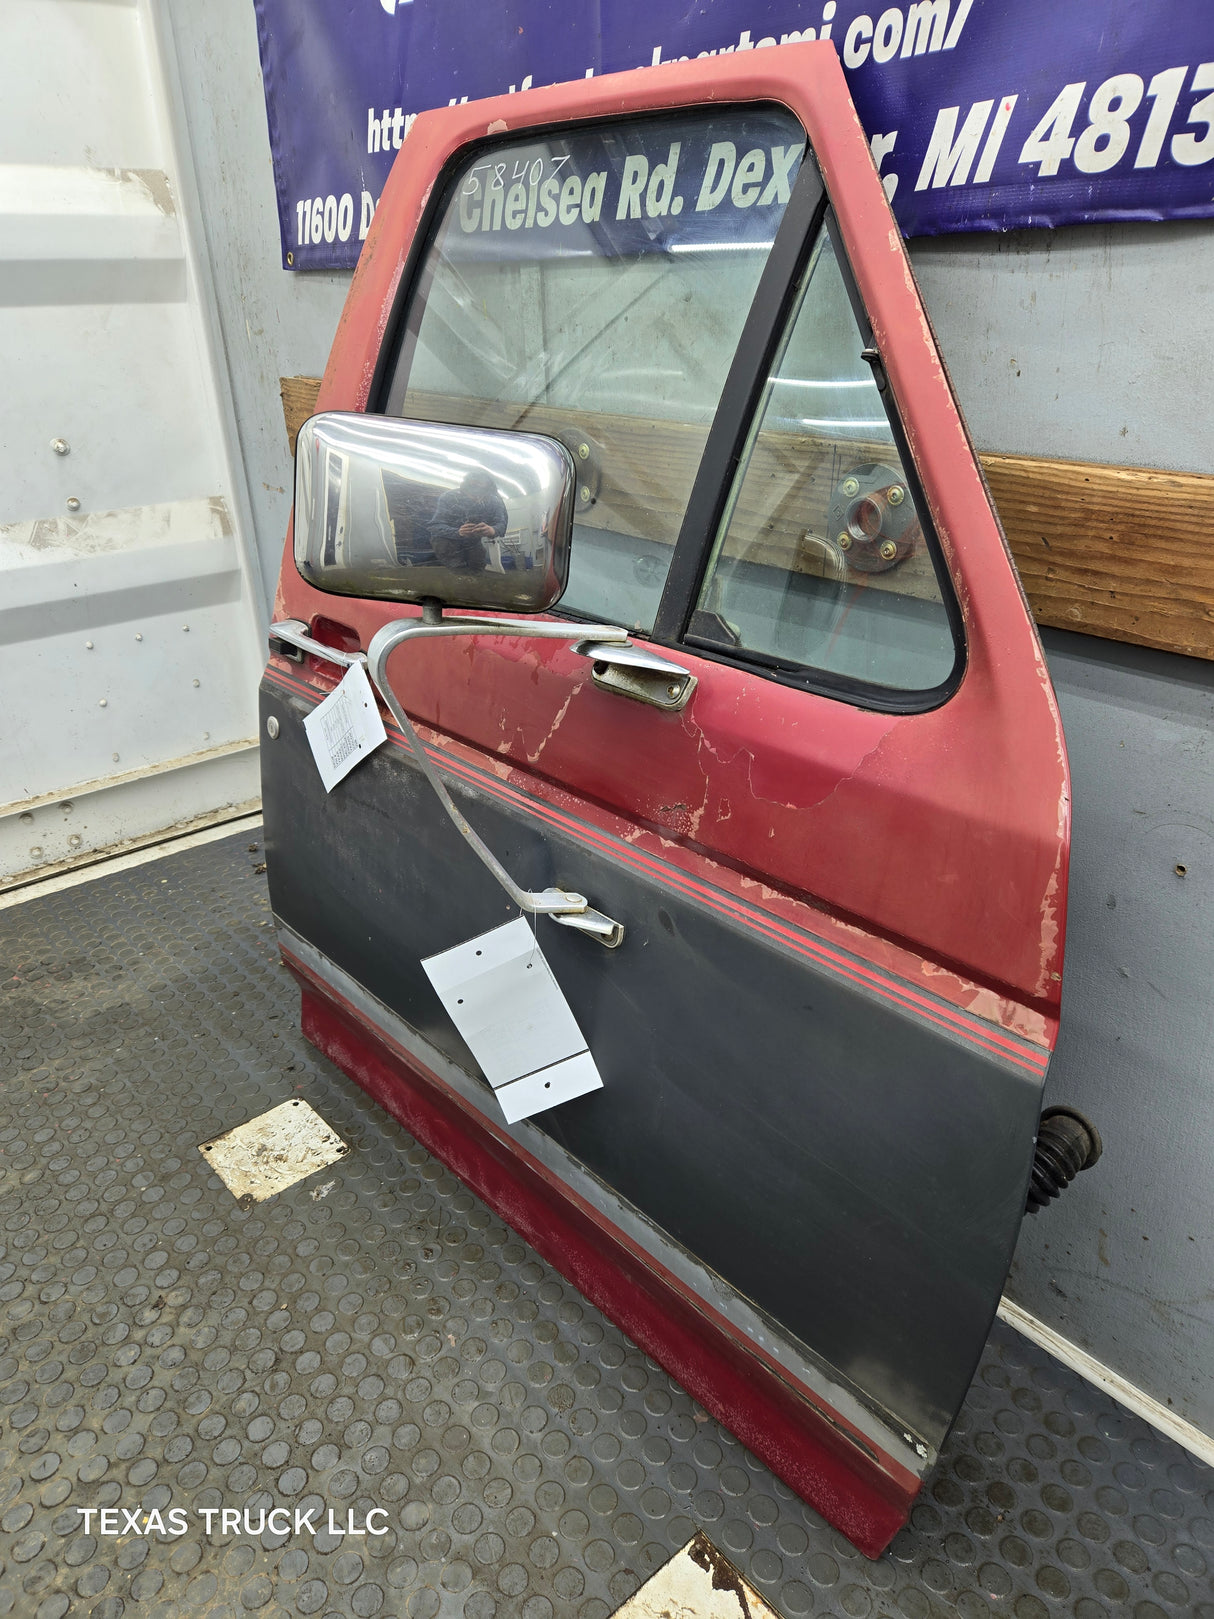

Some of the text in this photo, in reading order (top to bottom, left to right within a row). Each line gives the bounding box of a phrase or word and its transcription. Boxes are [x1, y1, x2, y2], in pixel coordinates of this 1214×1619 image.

[296, 193, 354, 245] 11600
[459, 168, 608, 233] Chelsea
[616, 141, 684, 221] Rd.
[914, 94, 1019, 192] MI
[462, 154, 571, 196] 58407
